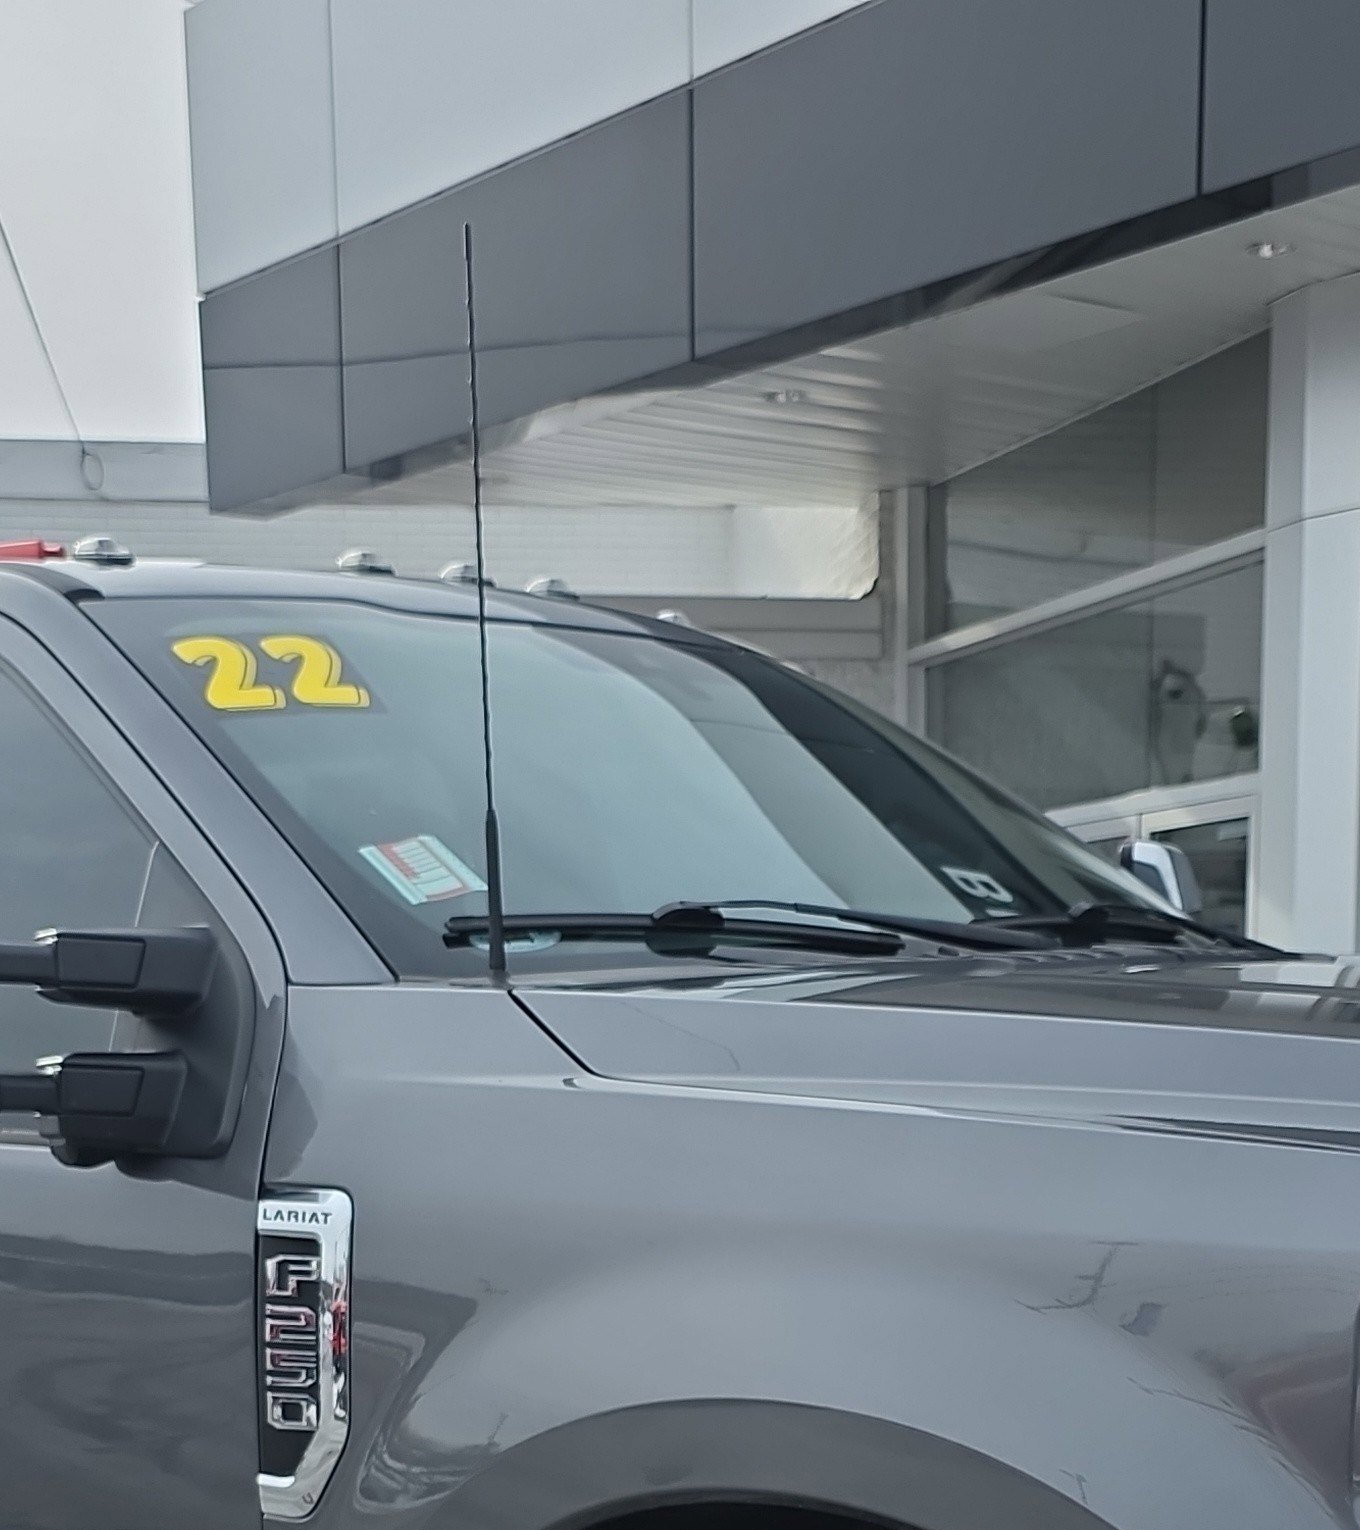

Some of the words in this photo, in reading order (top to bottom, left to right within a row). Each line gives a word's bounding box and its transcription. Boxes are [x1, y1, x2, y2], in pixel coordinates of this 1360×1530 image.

[171, 635, 371, 712] 22
[261, 1207, 333, 1226] LARIAT
[264, 1253, 322, 1431] F250
